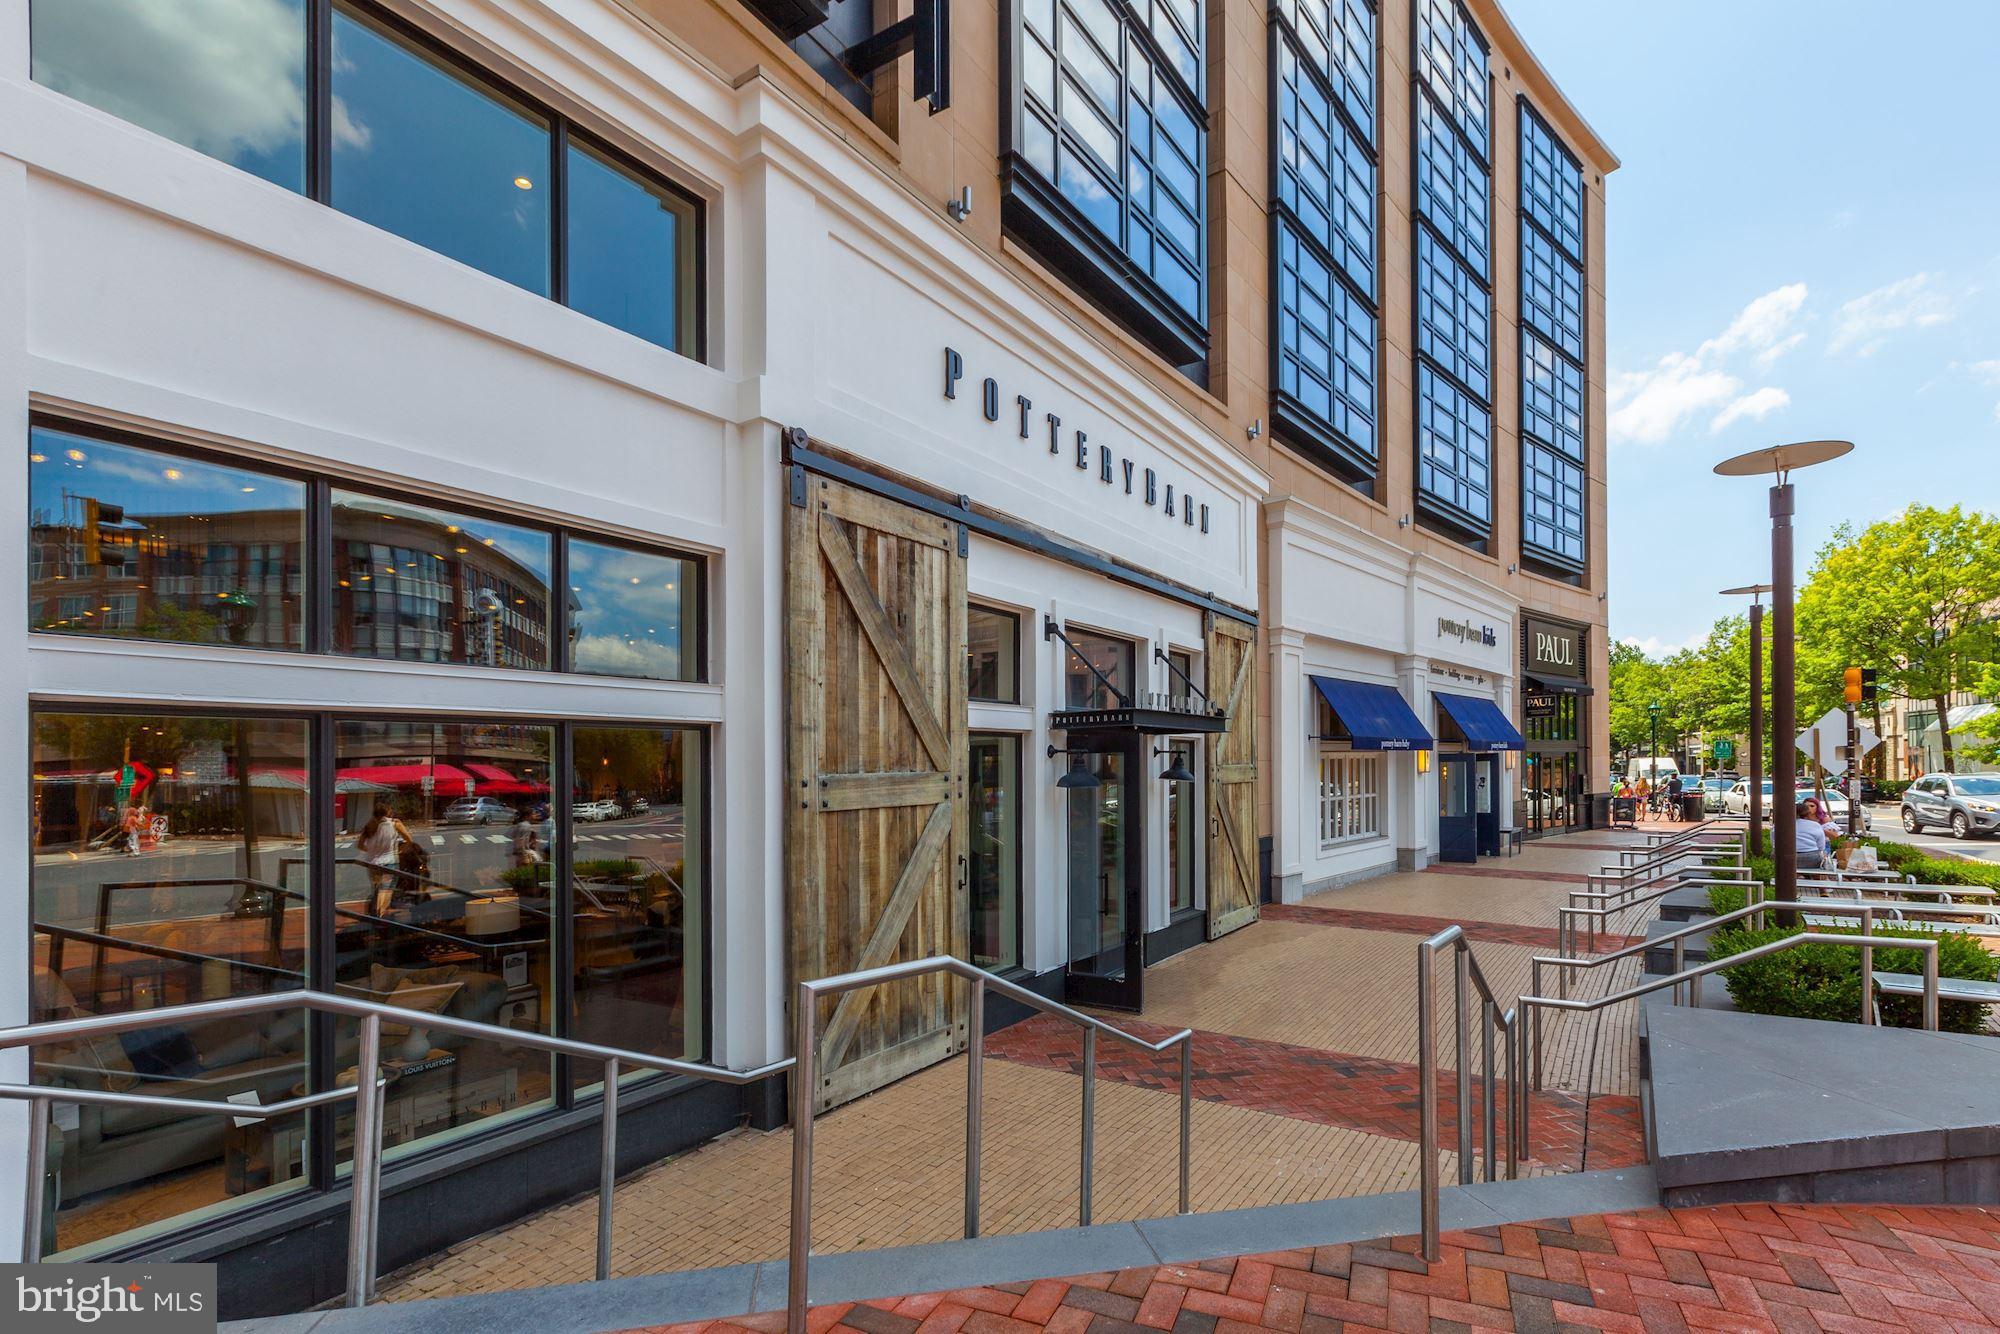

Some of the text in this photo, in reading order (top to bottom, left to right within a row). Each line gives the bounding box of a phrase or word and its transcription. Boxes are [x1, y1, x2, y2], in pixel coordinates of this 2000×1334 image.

[1536, 632, 1574, 666] PAUL
[1526, 698, 1555, 708] PAUL
[404, 1057, 453, 1075] LOUIS VUITTON
